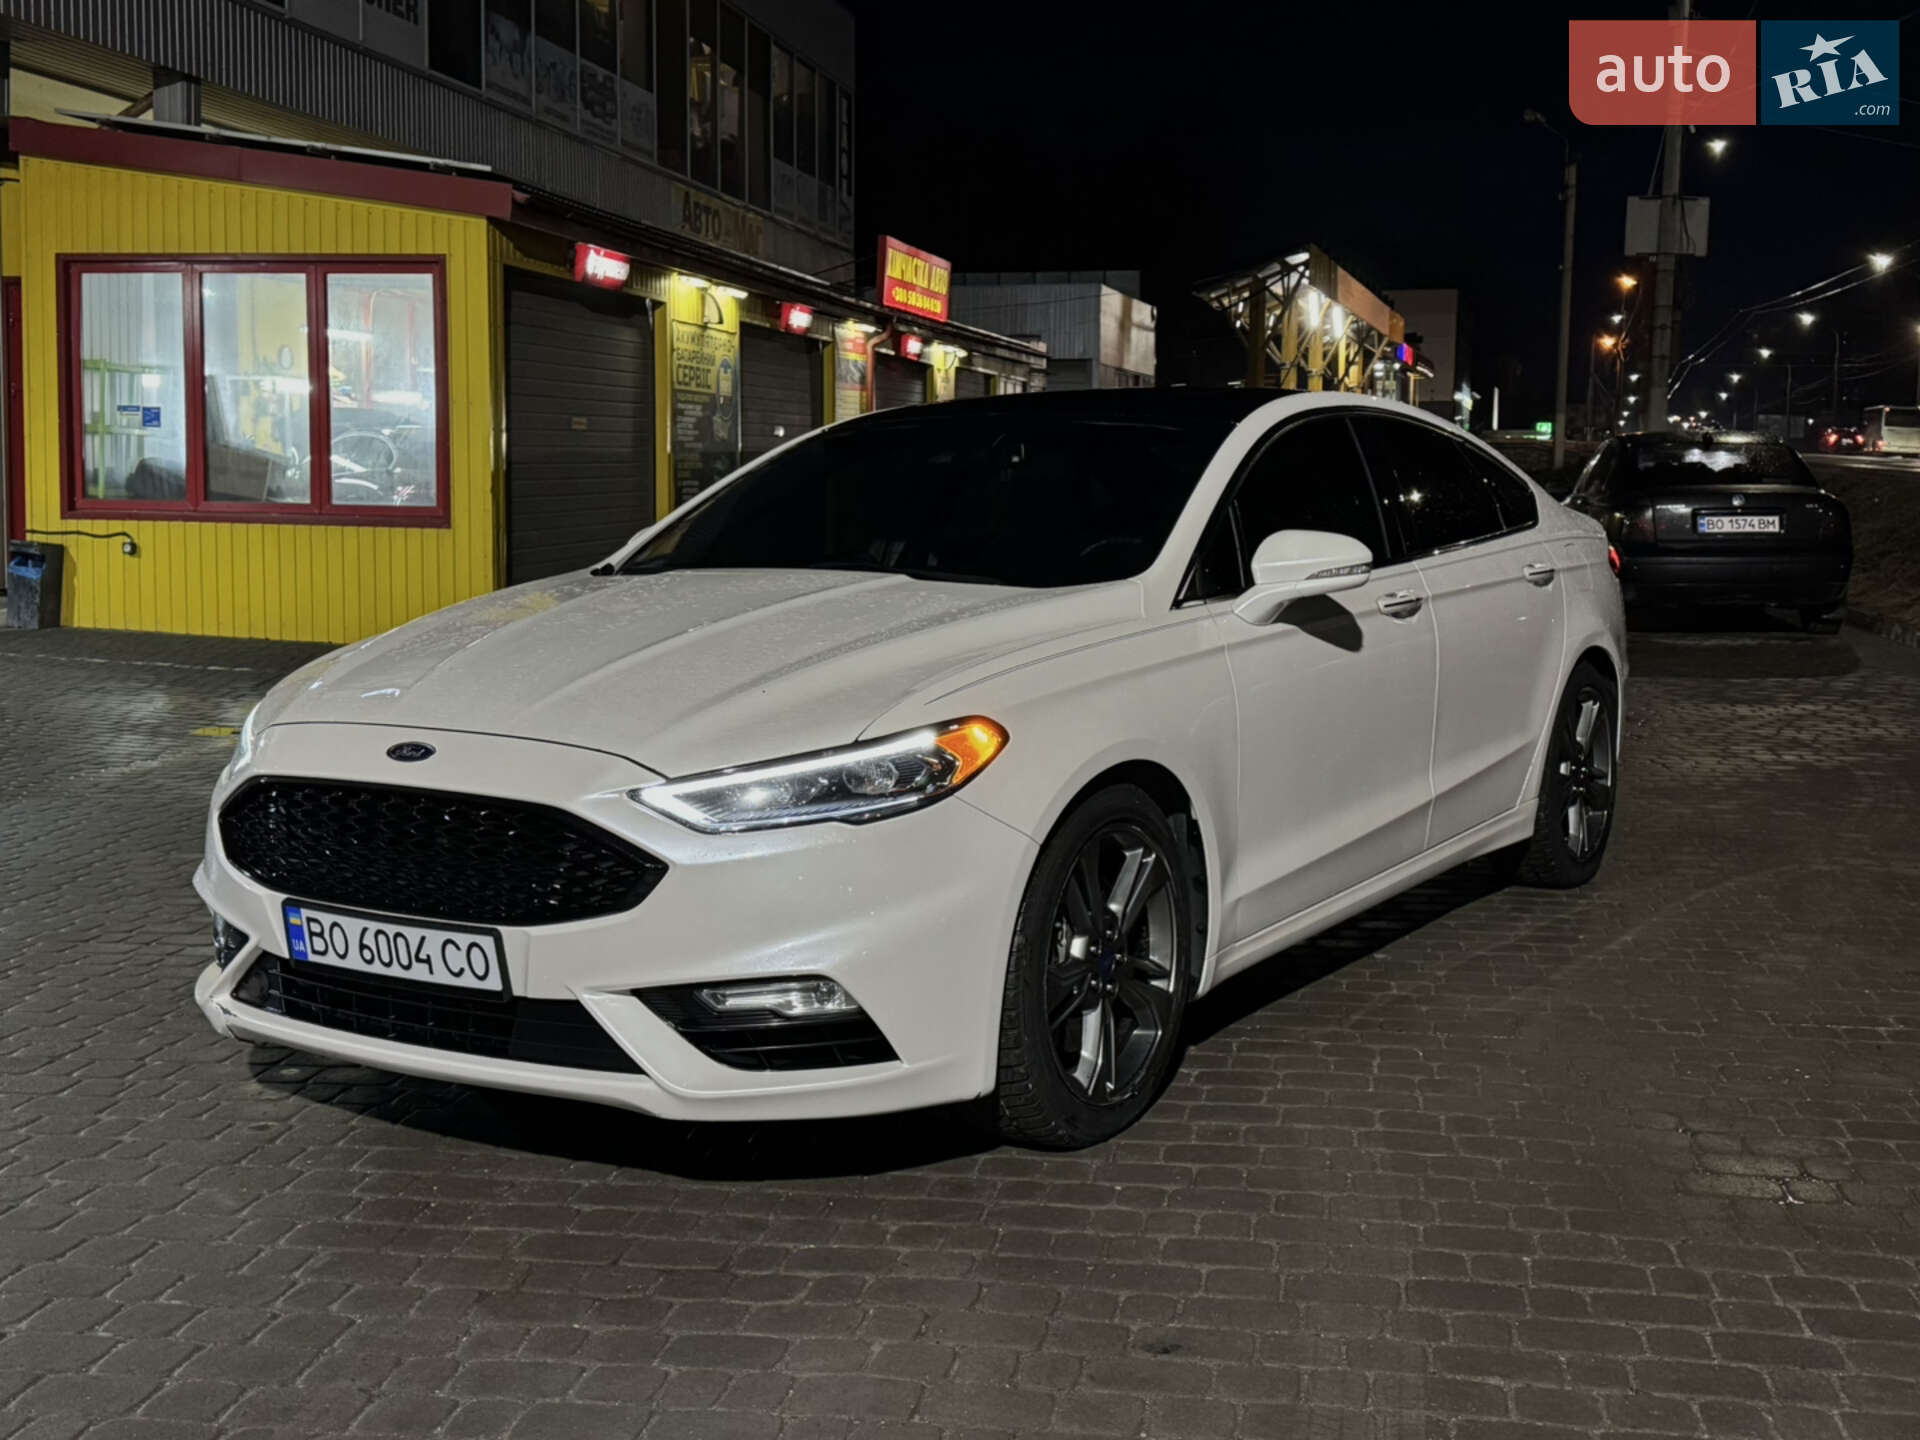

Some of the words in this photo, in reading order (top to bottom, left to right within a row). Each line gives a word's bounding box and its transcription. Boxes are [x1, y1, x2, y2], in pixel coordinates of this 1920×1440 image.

[1706, 519, 1725, 530] BO
[1728, 519, 1755, 529] 1574
[1758, 518, 1777, 529] BM
[292, 938, 306, 953] UA
[306, 916, 349, 960] BO
[358, 926, 434, 976] 6004
[441, 938, 490, 981] CO
